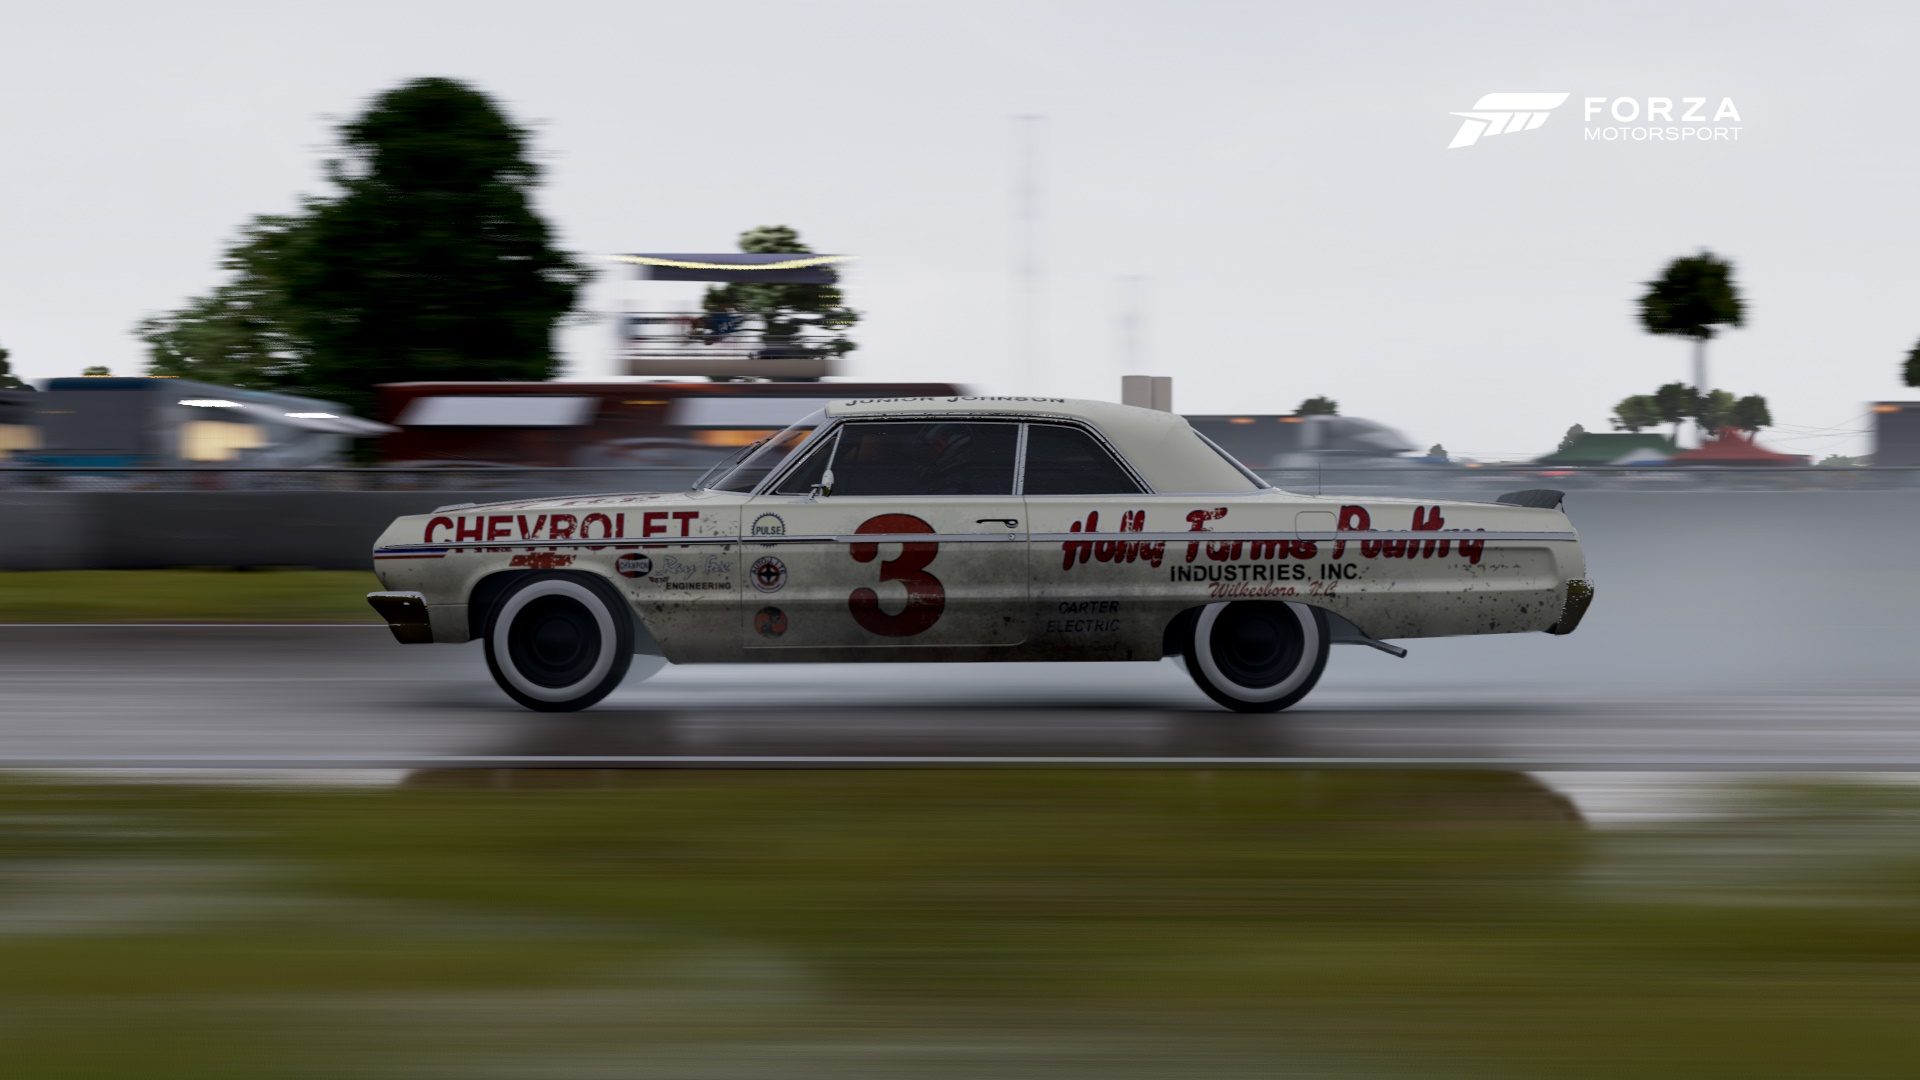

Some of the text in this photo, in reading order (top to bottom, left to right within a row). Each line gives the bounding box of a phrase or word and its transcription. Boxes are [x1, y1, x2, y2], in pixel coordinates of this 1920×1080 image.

[424, 511, 700, 553] CHEVROLET
[756, 526, 782, 535] PULSE
[1062, 505, 1486, 571] Holly Farms Poultry
[848, 513, 946, 637] 3
[1170, 563, 1362, 583] INDUSTRIES, INC.
[665, 582, 732, 591] ENGINEERING
[1208, 580, 1300, 598] Wilkesboro,
[1058, 601, 1121, 615] CARTER
[1046, 619, 1121, 633] ELECTRIC
